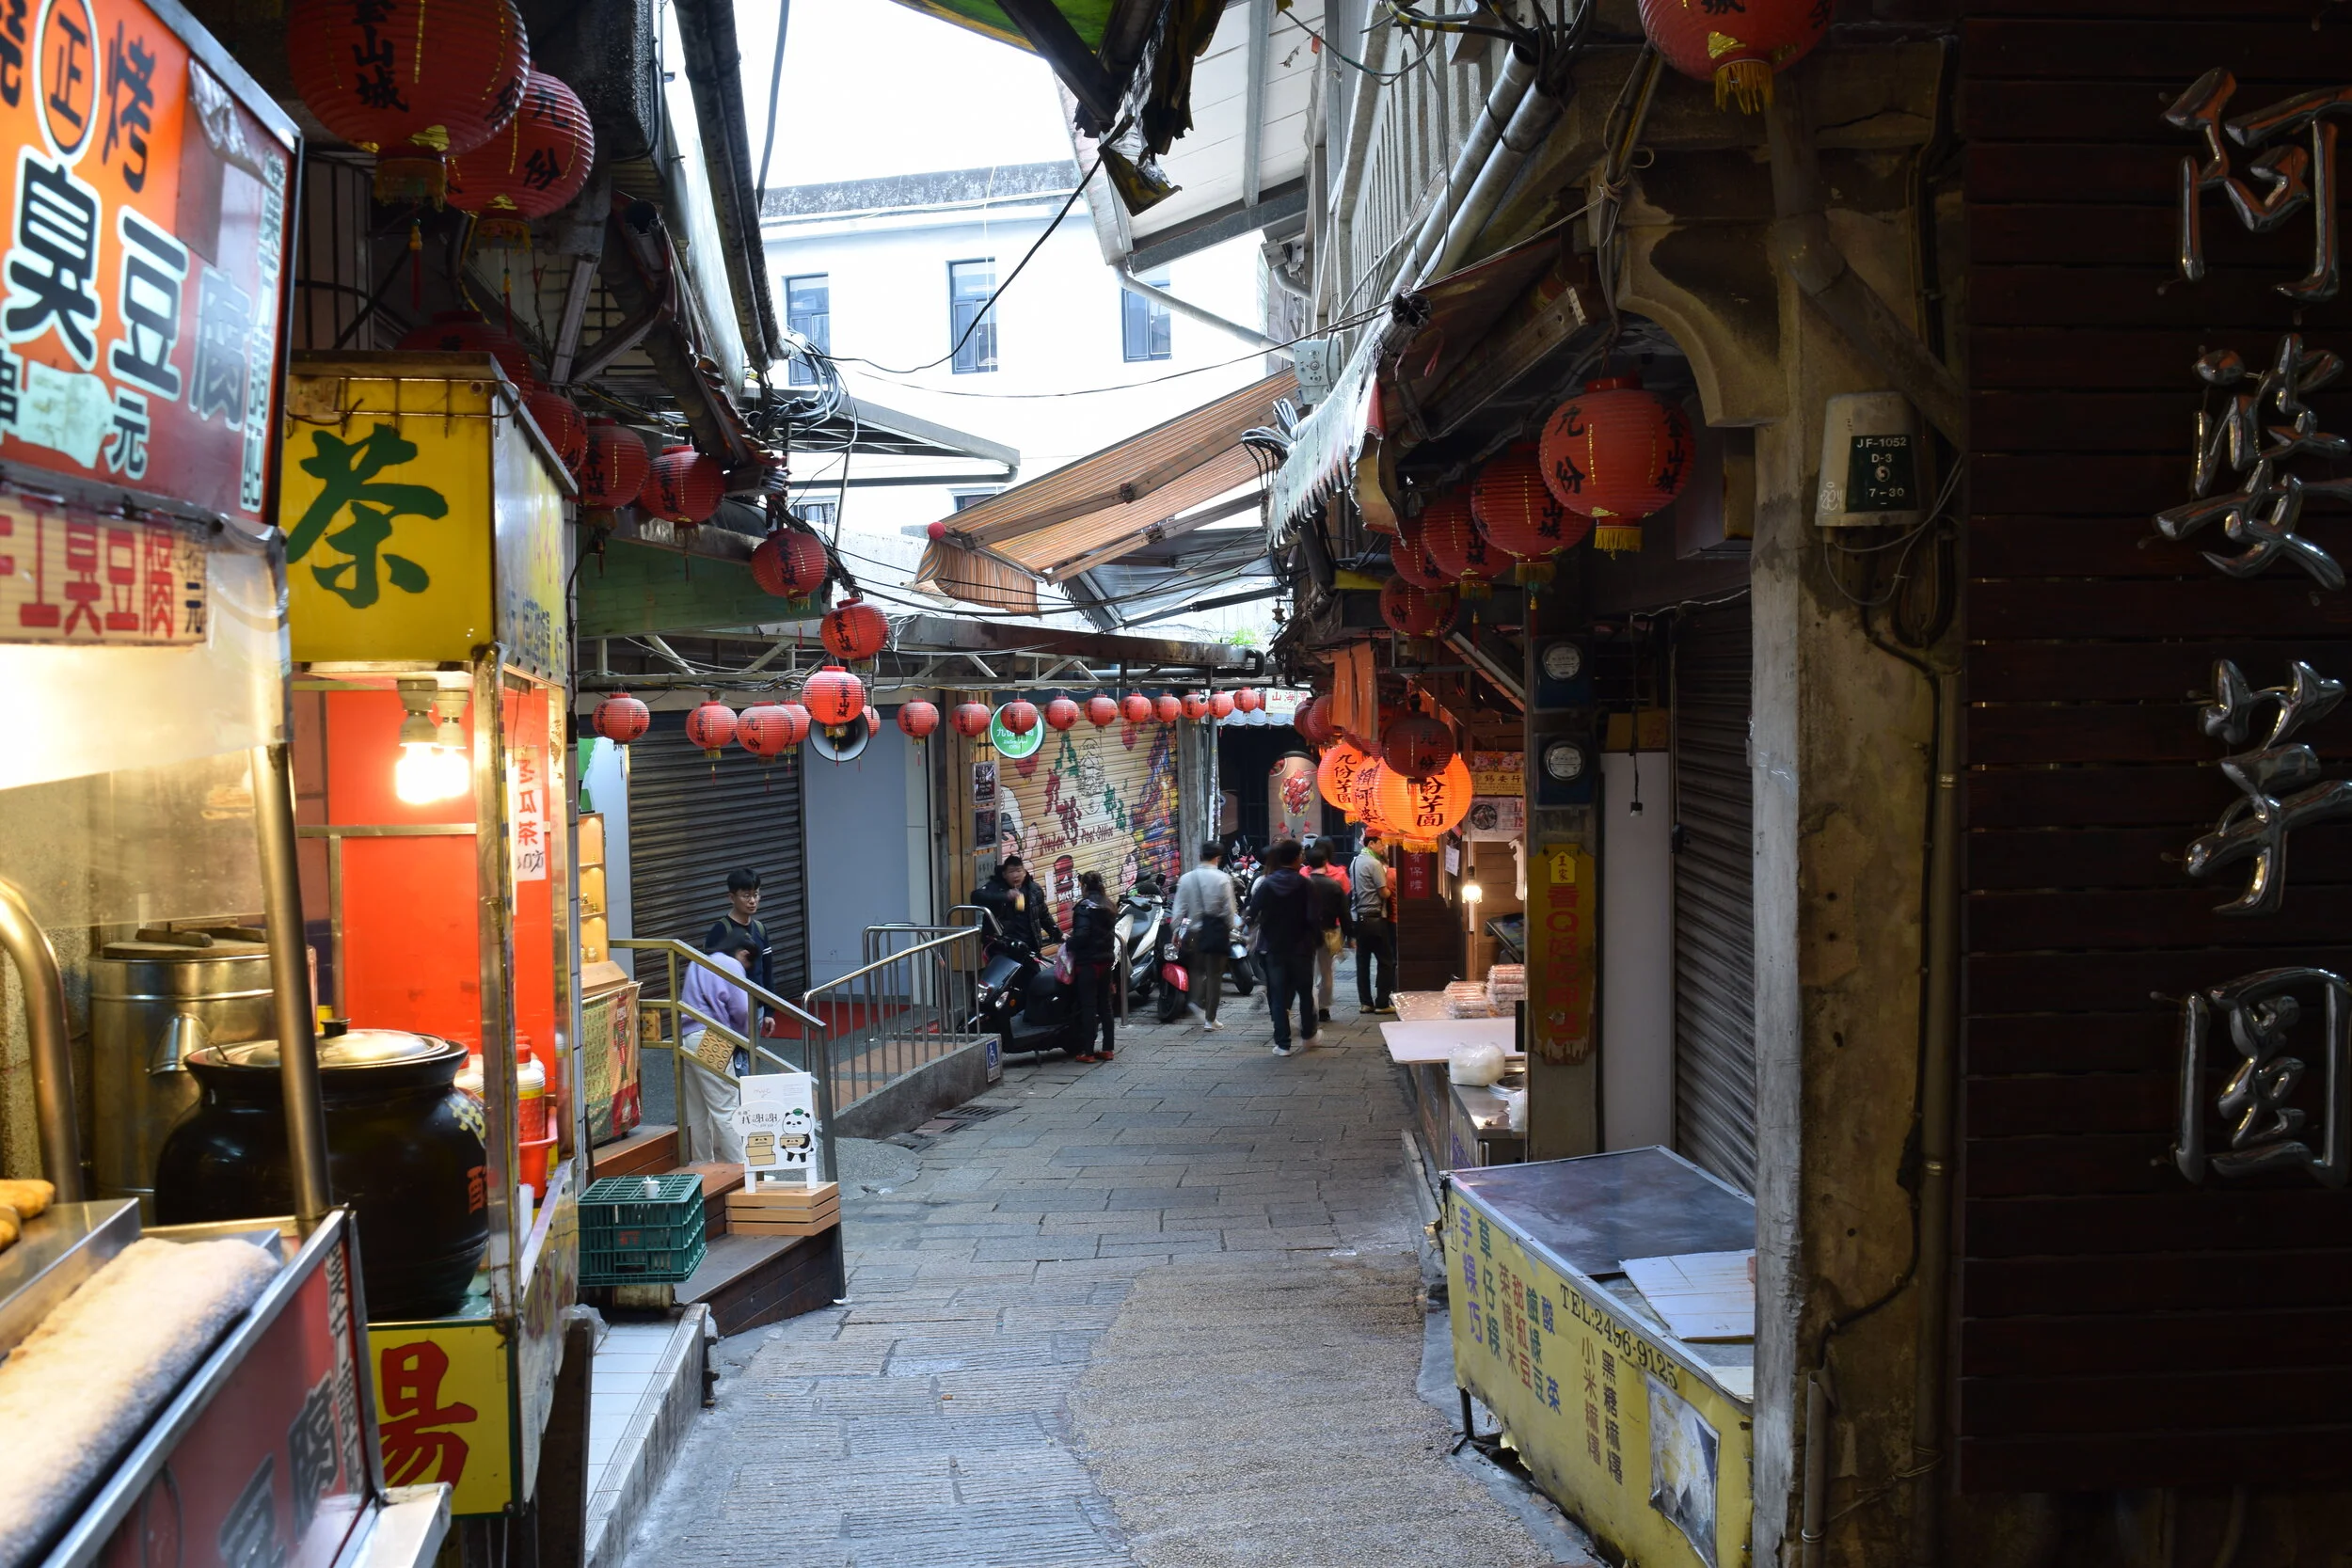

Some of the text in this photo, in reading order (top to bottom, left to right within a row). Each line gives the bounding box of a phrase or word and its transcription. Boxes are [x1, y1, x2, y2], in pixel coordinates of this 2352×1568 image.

[50, 11, 87, 130] 正
[103, 19, 155, 194] 烤
[524, 86, 569, 191] 九份
[4, 150, 246, 428] 臭豆腐
[111, 393, 147, 473] 元
[1555, 405, 1585, 494] 九份
[1871, 453, 1893, 463] D-3
[286, 423, 449, 610] 茶
[2154, 66, 2352, 1190] 阿婆芋圓
[745, 717, 761, 751] 九份
[1333, 753, 1358, 803] 九份芋圓
[1417, 771, 1447, 827] 份芋圓
[1557, 855, 1569, 882] 王家
[1459, 1205, 1484, 1344] 芋粿巧
[1477, 1217, 1502, 1362] 草仔粿
[1512, 1274, 1533, 1390] 甜紅豆
